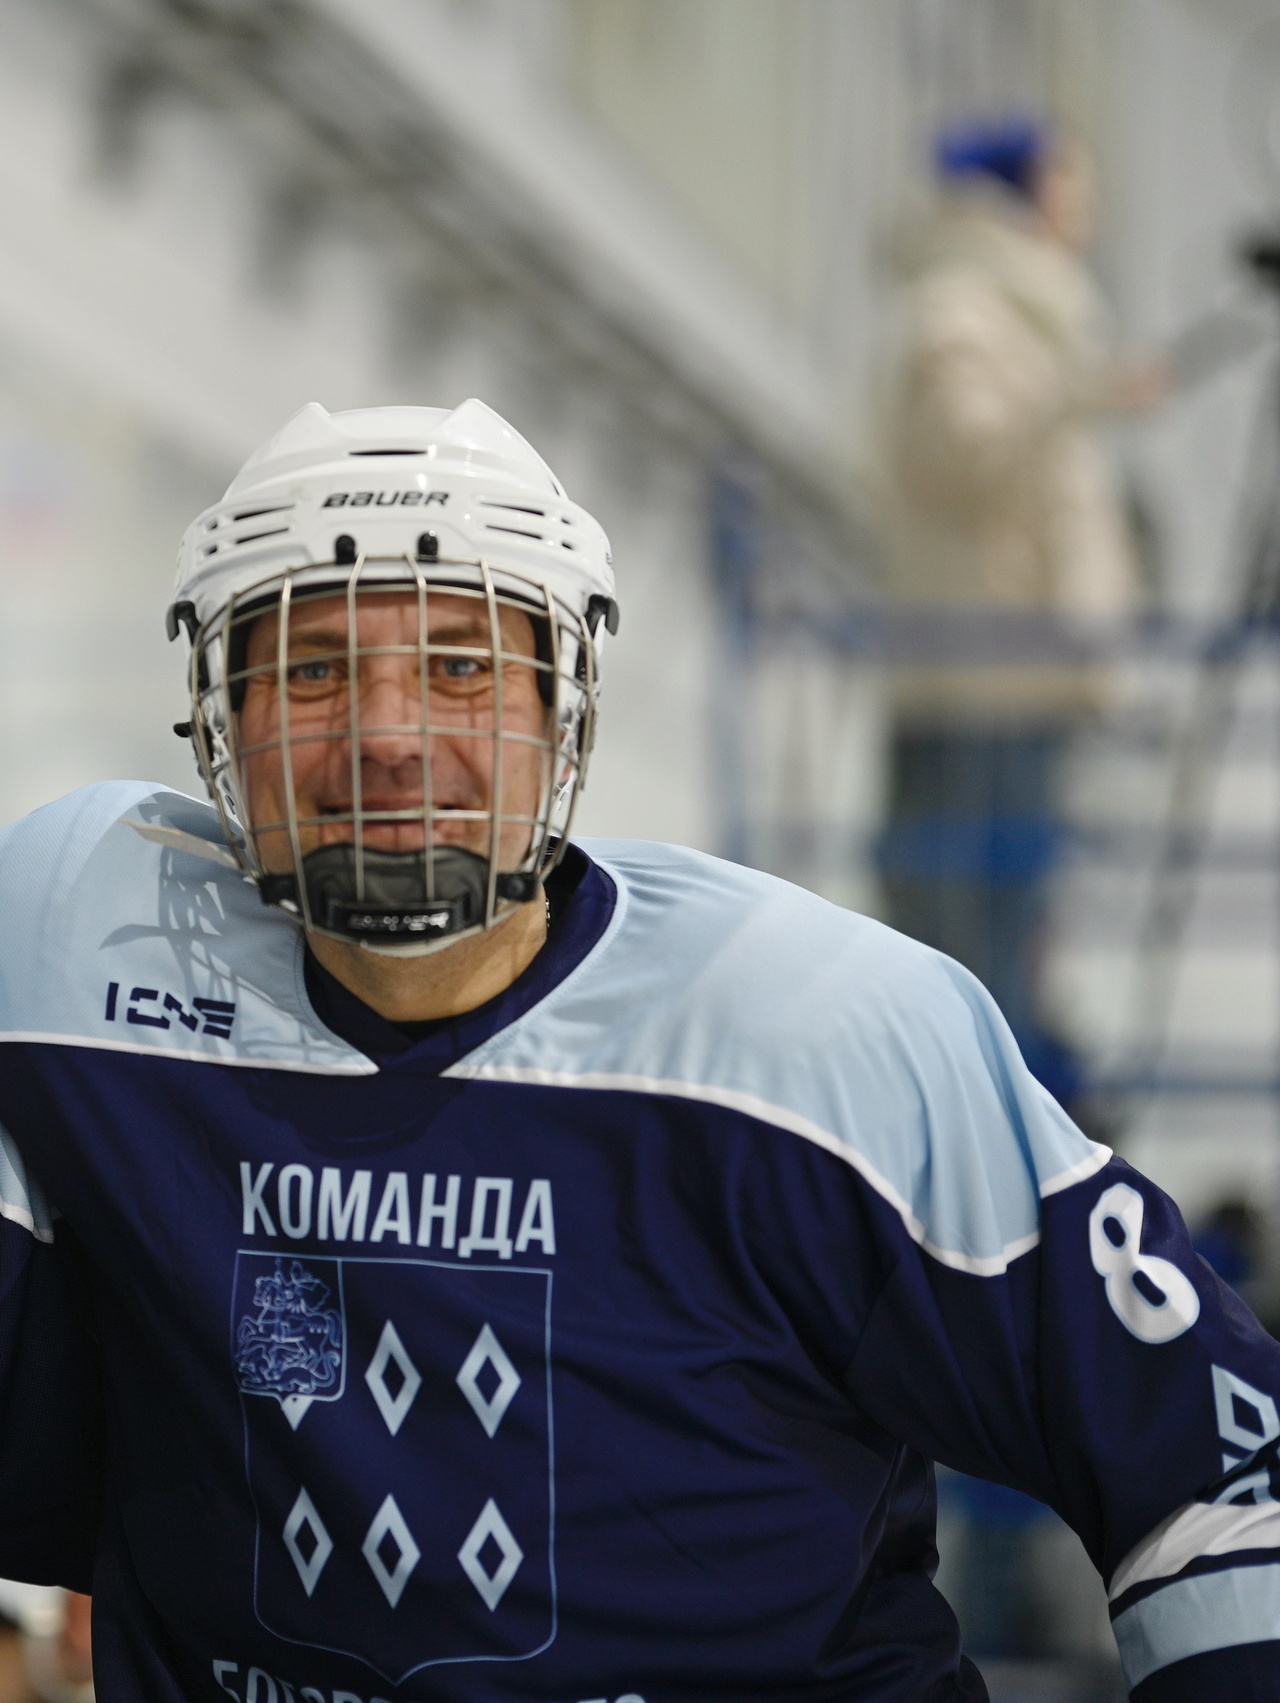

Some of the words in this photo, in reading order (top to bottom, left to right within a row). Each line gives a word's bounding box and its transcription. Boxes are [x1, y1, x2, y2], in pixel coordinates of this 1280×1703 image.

[320, 490, 449, 508] BAUER
[239, 1161, 556, 1259] КОМАНДА
[1088, 1182, 1201, 1344] 8
